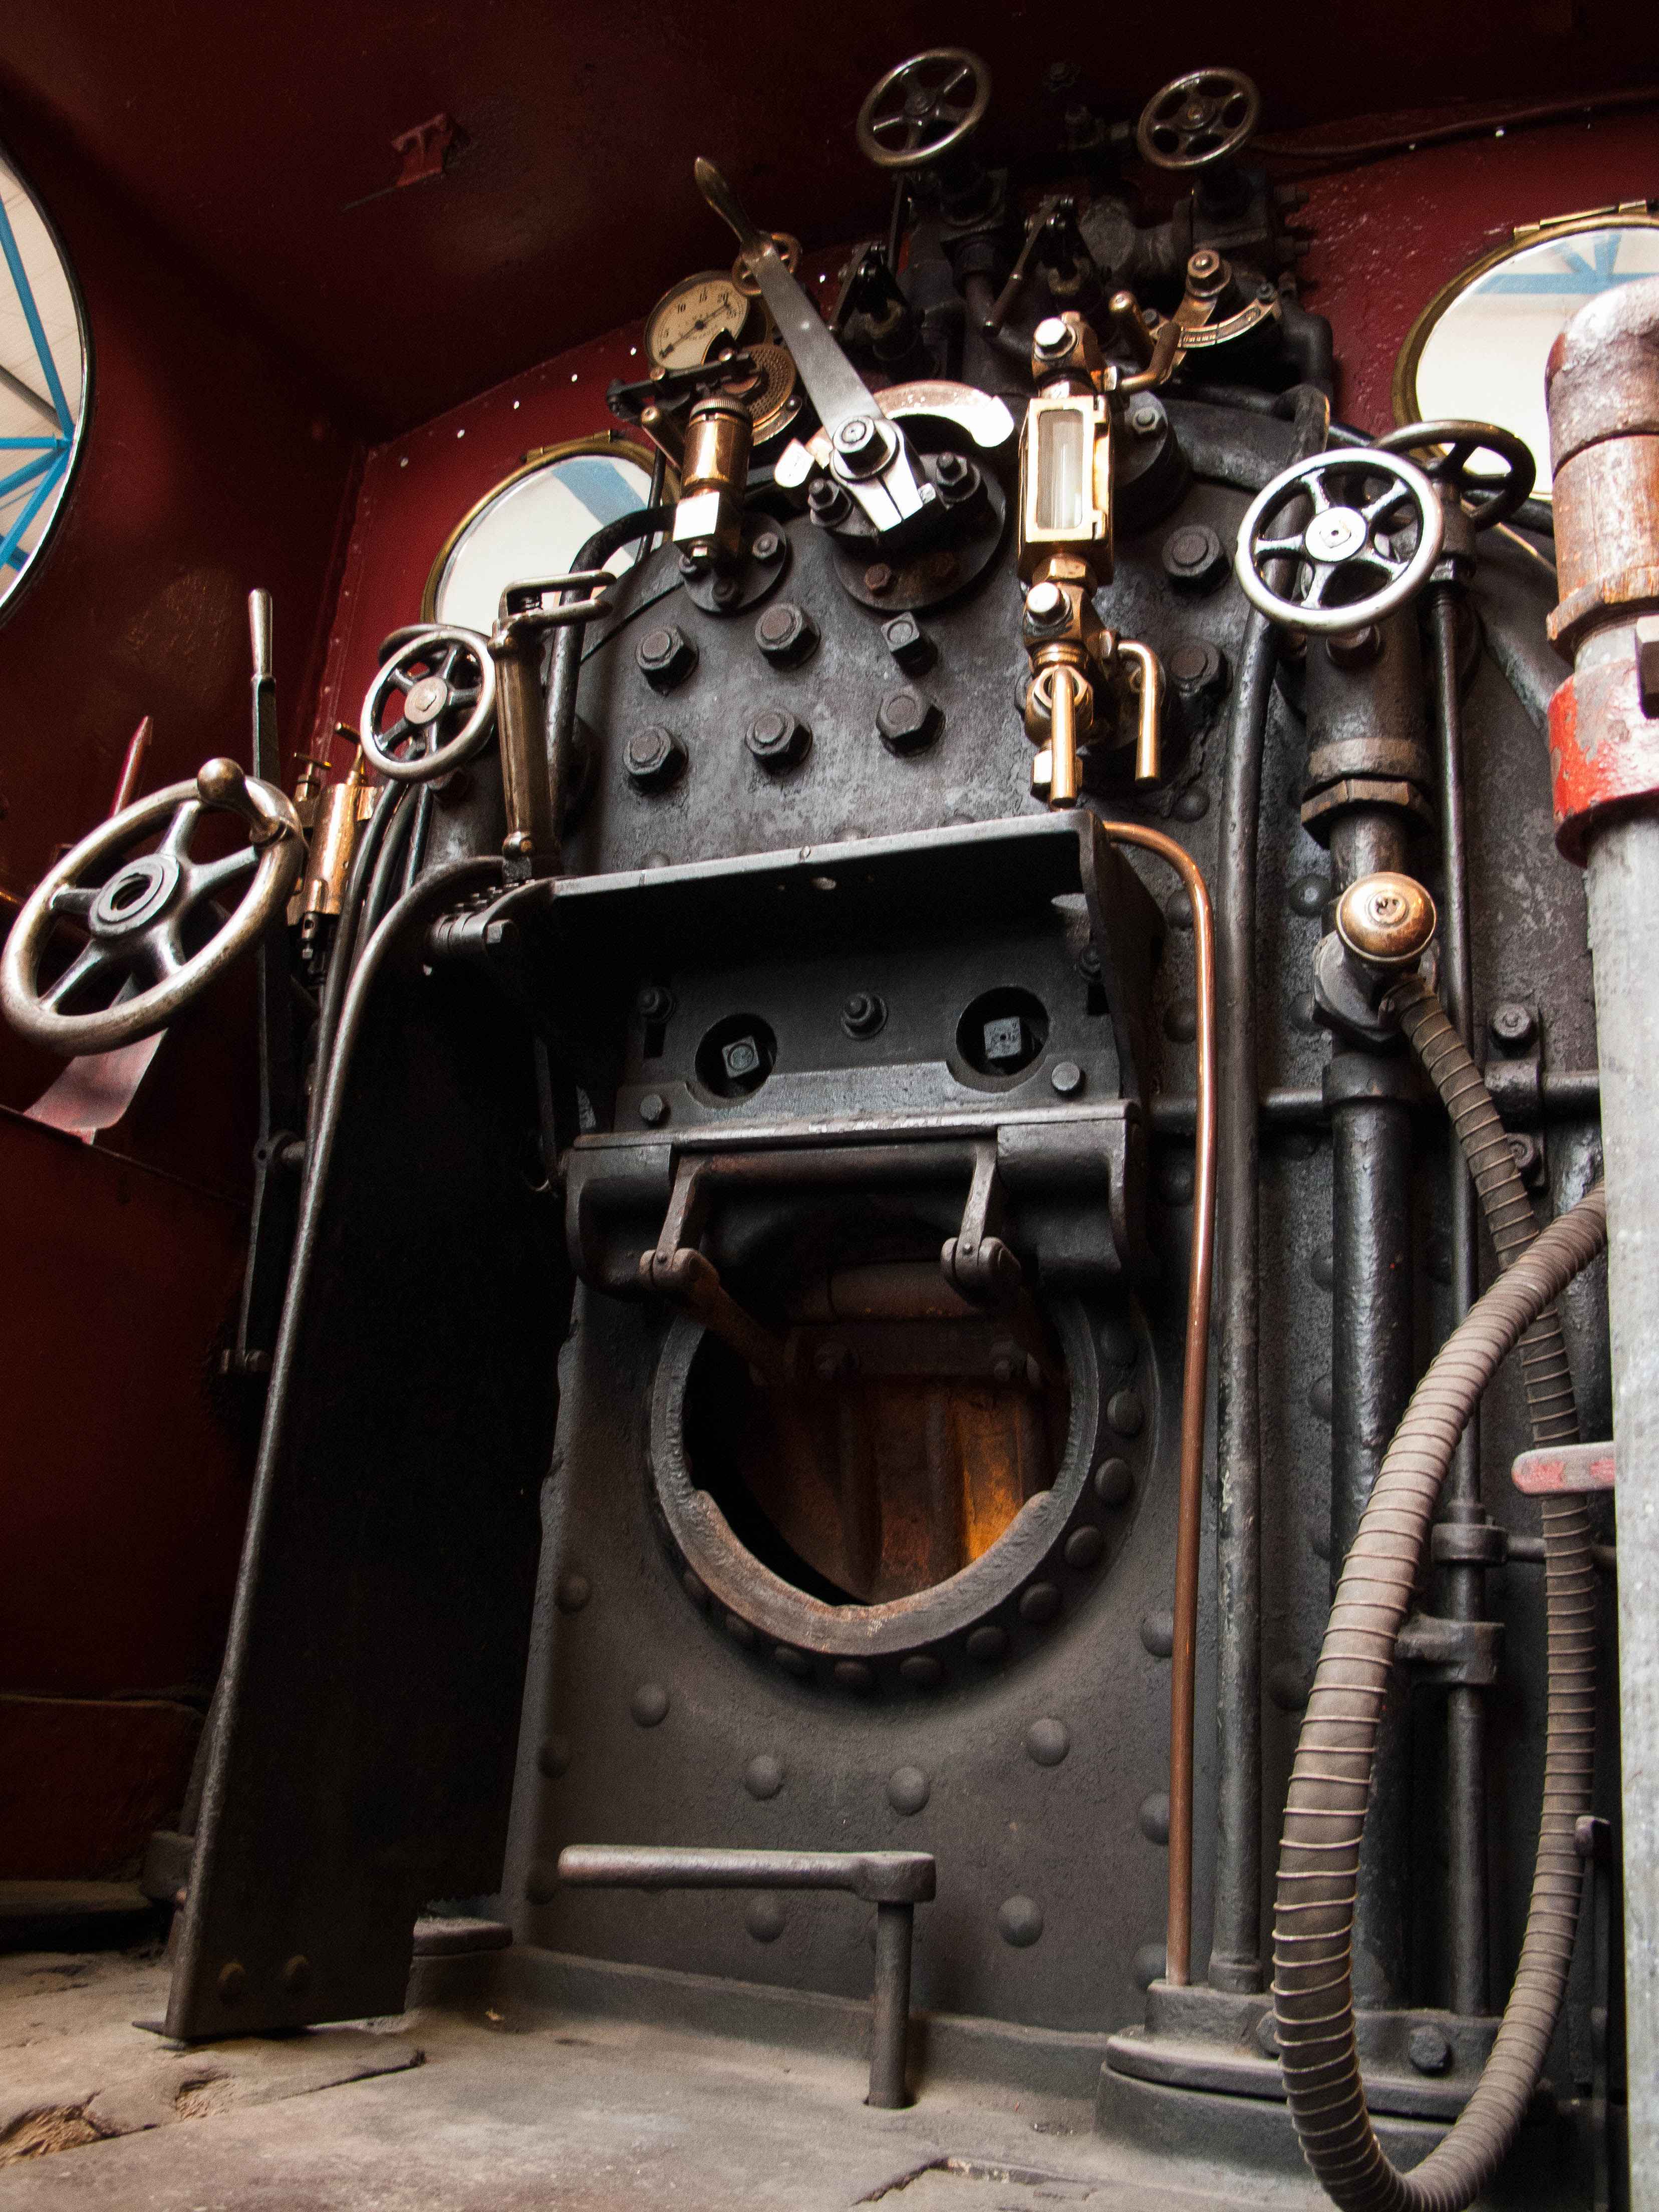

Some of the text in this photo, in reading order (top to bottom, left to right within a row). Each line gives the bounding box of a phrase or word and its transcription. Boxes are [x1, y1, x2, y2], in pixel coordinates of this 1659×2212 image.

[699, 290, 708, 304] 15
[718, 292, 729, 304] 20
[677, 303, 687, 314] 10
